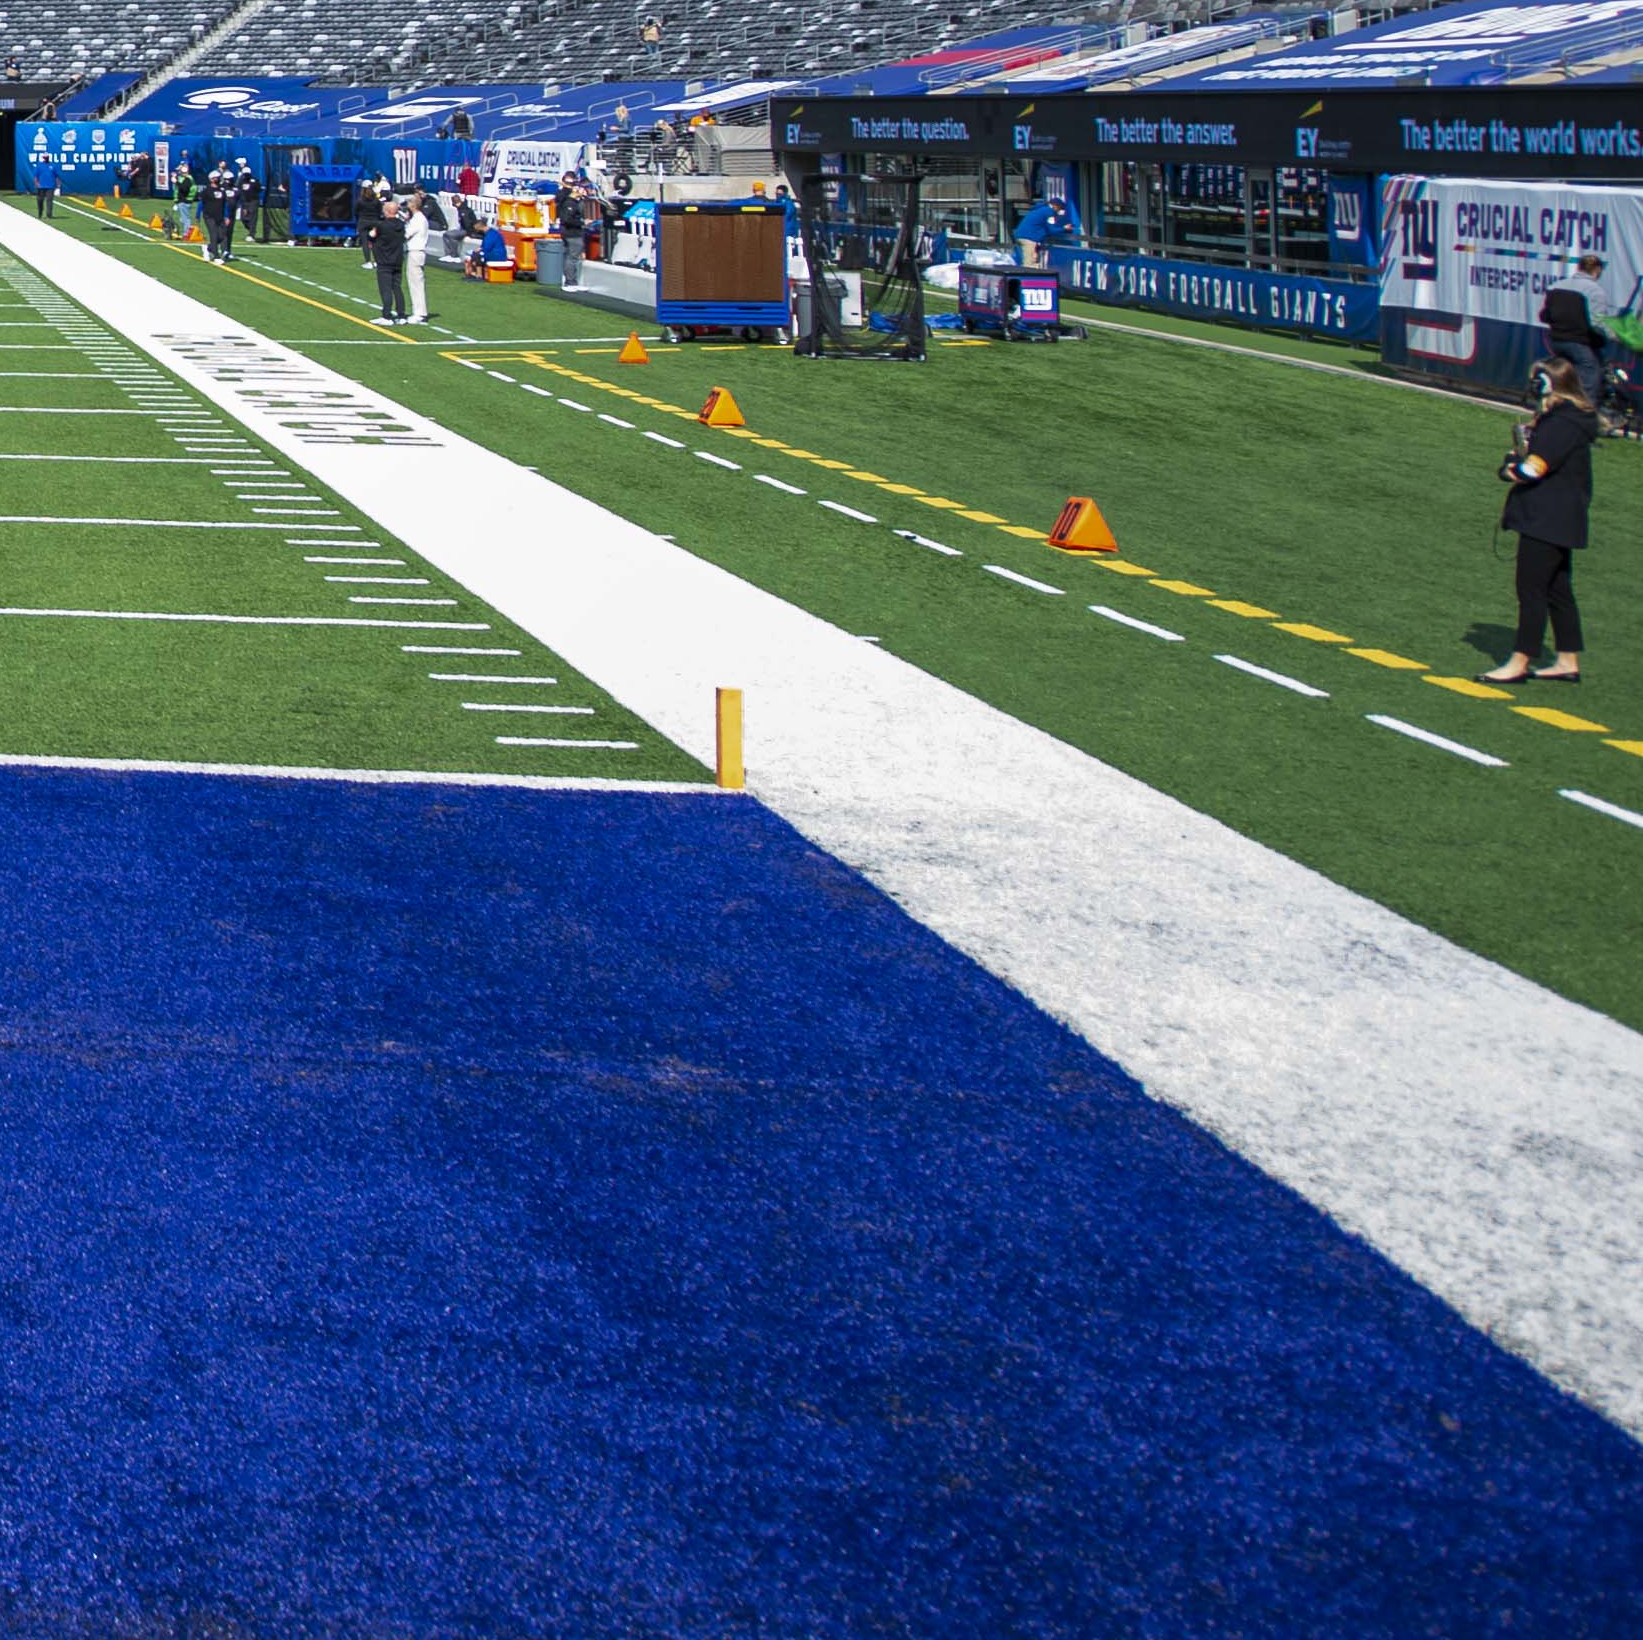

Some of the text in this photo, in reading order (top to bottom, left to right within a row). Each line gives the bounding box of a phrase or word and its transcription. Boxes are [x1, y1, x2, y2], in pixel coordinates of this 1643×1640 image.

[786, 124, 800, 144] EY
[851, 117, 970, 144] The better the question.
[1014, 126, 1030, 150] EY
[1095, 118, 1238, 146] The better the answer.
[1296, 128, 1318, 158] EY
[1399, 119, 1430, 151] The
[1433, 120, 1487, 152] better
[1490, 120, 1520, 153] the
[1523, 120, 1577, 156] world
[419, 165, 438, 179] NEW
[507, 151, 561, 166] CRUCIAL CATCH
[1334, 192, 1361, 241] ny
[1456, 202, 1608, 253] CRUCIAL CATCH
[1401, 200, 1439, 281] ny
[1470, 265, 1530, 292] INTERCEPT
[1022, 288, 1052, 311] ny
[1072, 259, 1346, 329] NEW YORK FOOTBALL GIANTS
